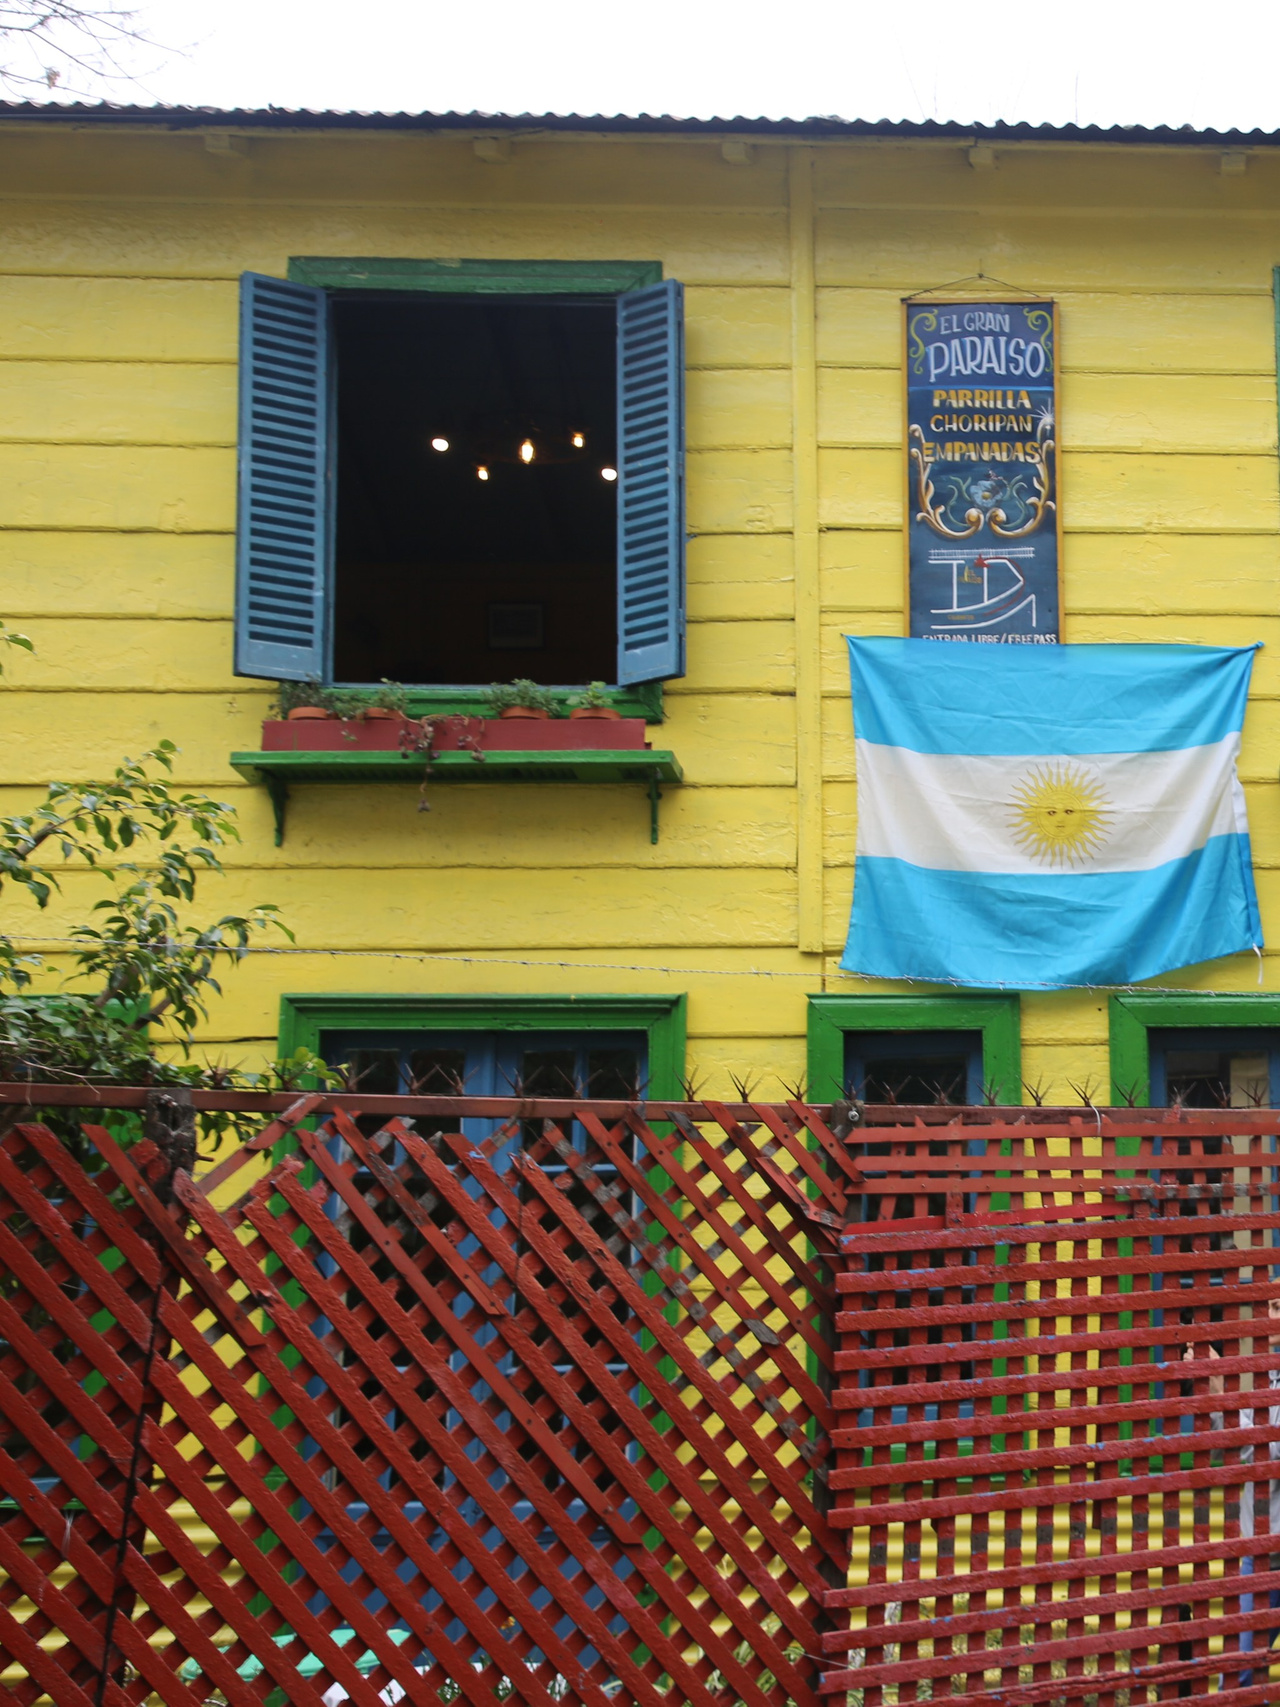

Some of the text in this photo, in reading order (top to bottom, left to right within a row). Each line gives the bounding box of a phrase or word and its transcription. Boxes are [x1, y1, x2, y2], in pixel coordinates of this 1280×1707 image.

[940, 311, 1011, 335] EL GRAN
[927, 336, 1046, 383] PARAISO
[932, 389, 1032, 410] PARRILLA
[930, 413, 1033, 434] CHORIPAN
[922, 441, 1041, 464] EMPANADAS
